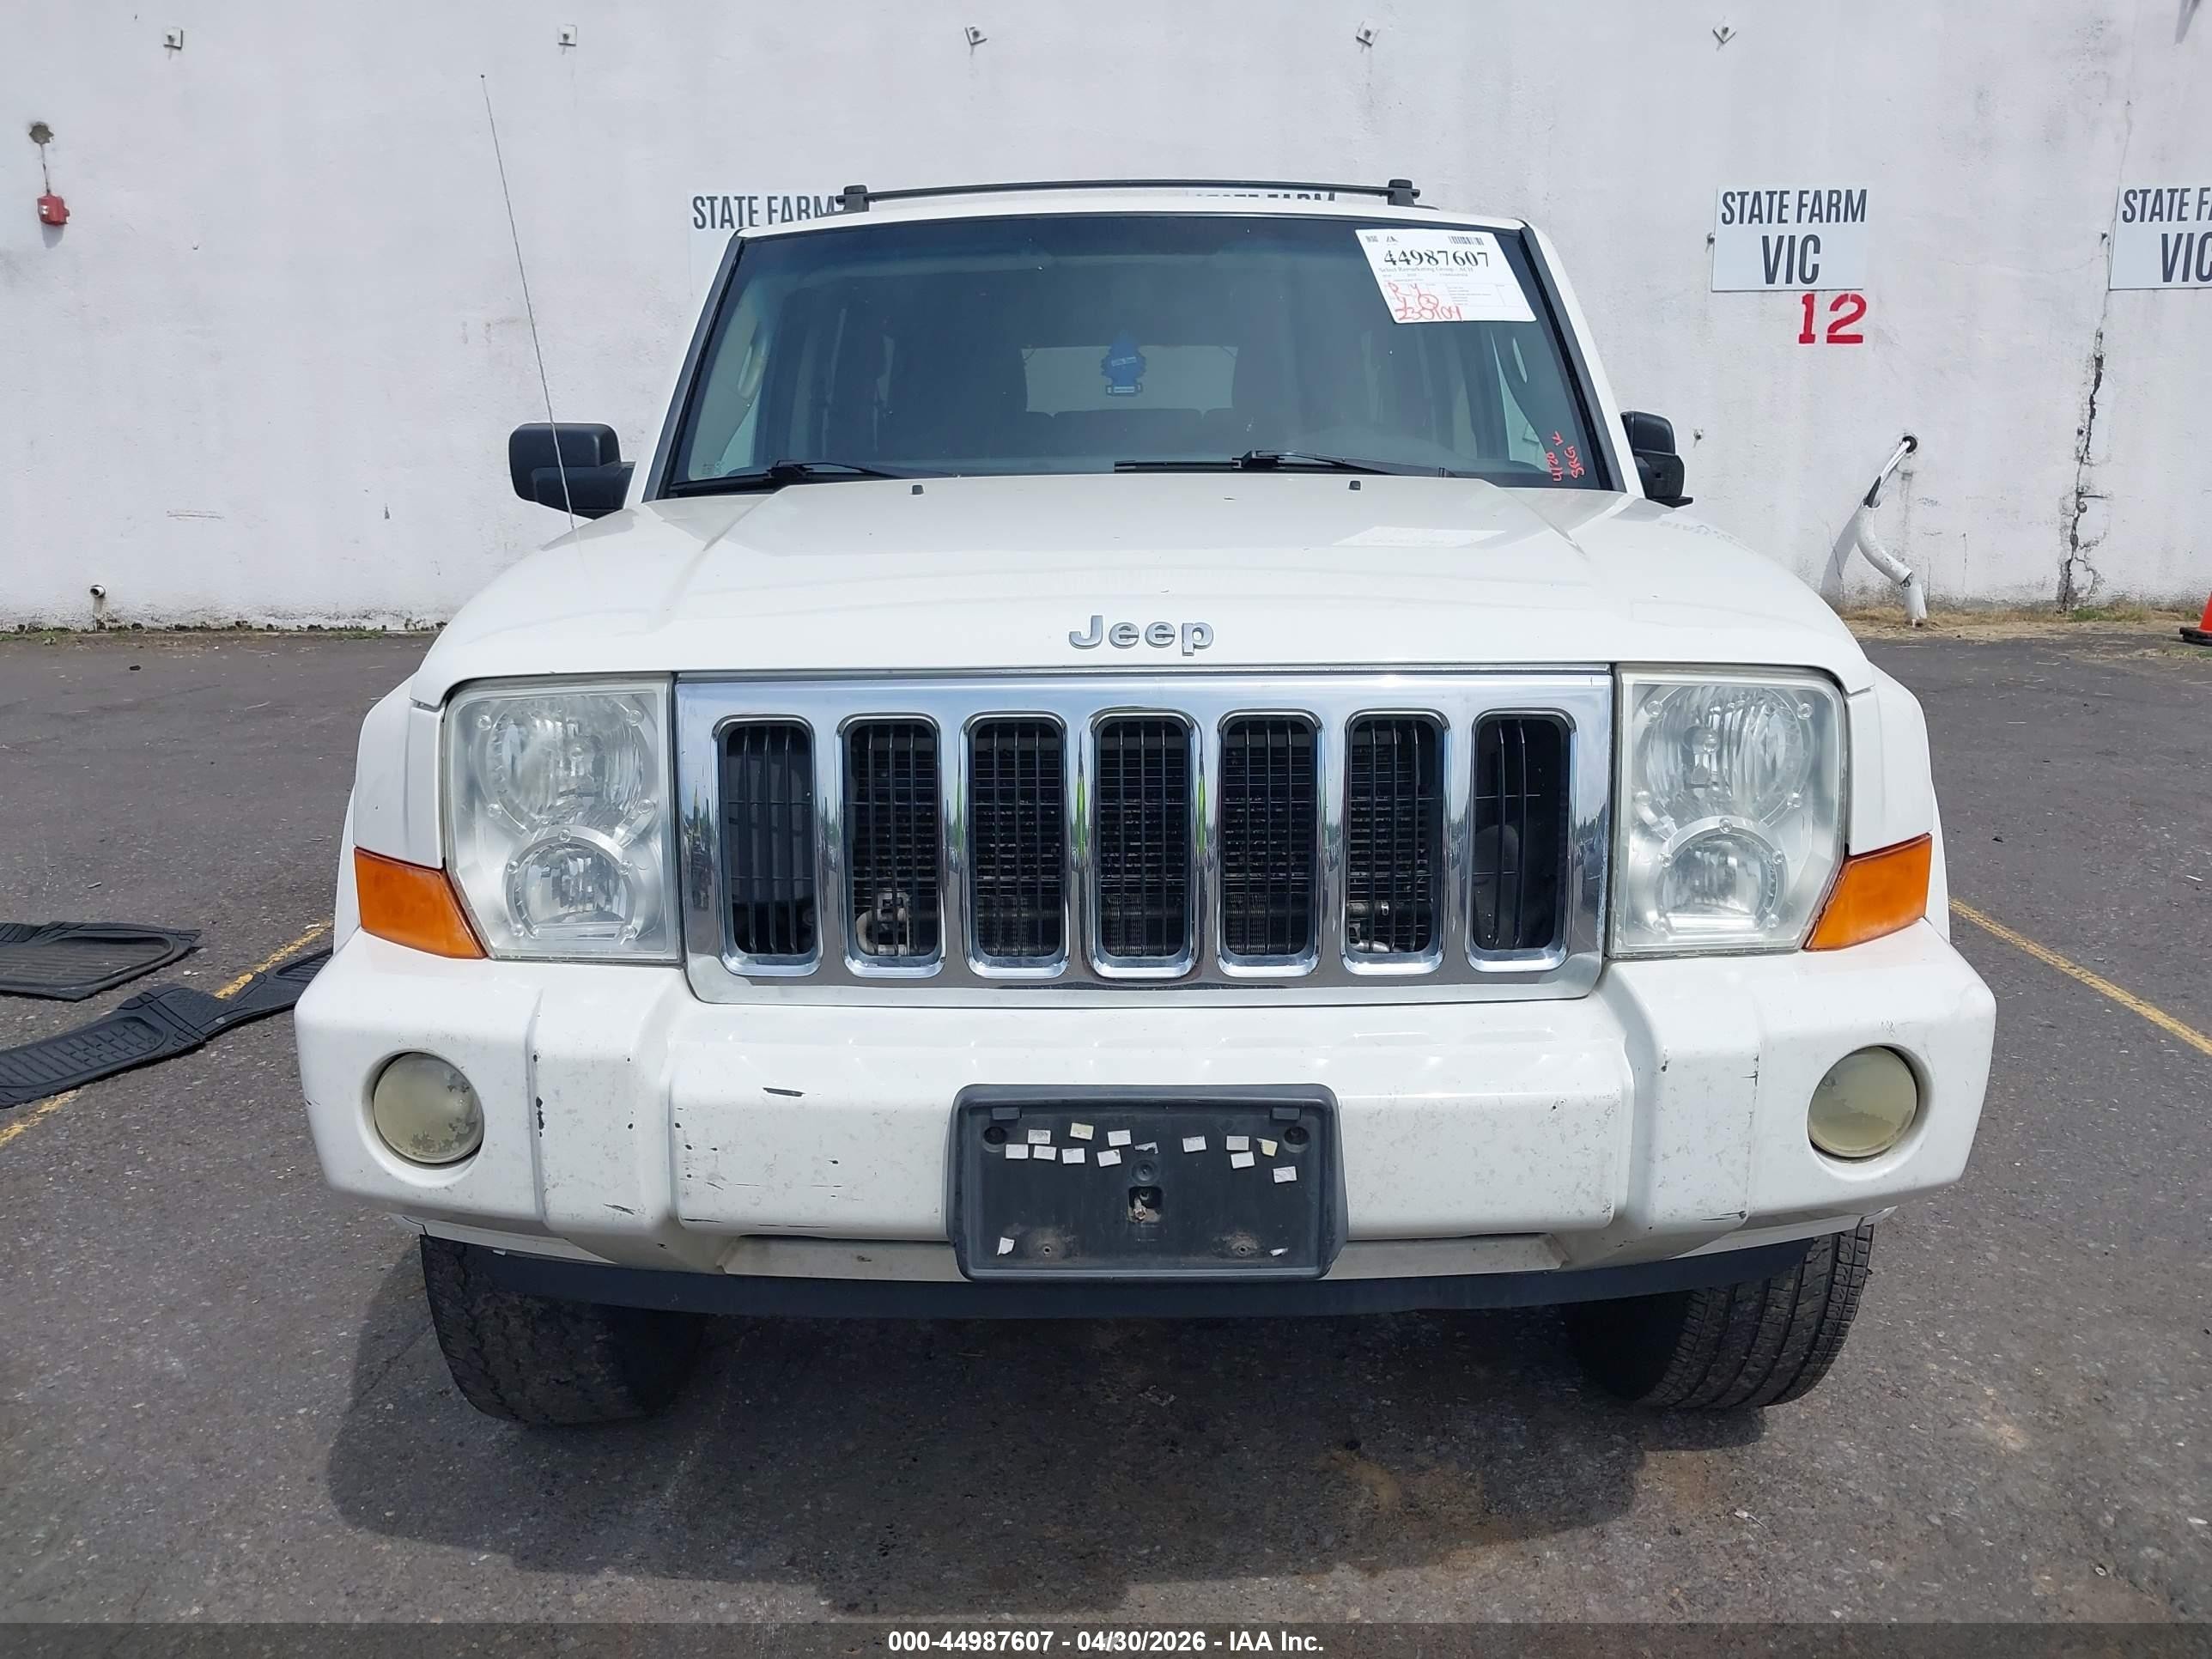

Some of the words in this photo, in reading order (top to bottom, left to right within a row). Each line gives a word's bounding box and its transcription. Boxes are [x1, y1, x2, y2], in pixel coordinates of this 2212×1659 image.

[692, 195, 759, 229] STATE
[767, 195, 836, 225] FARM
[1721, 190, 1790, 225] STATE
[1796, 189, 1867, 223] FARM
[2122, 188, 2191, 223] STATE
[1384, 249, 1489, 267] 44987607
[1761, 234, 1821, 285] VIC
[2161, 231, 2212, 283] VIC
[1799, 294, 1867, 343] 12
[1069, 615, 1214, 657] Jeep
